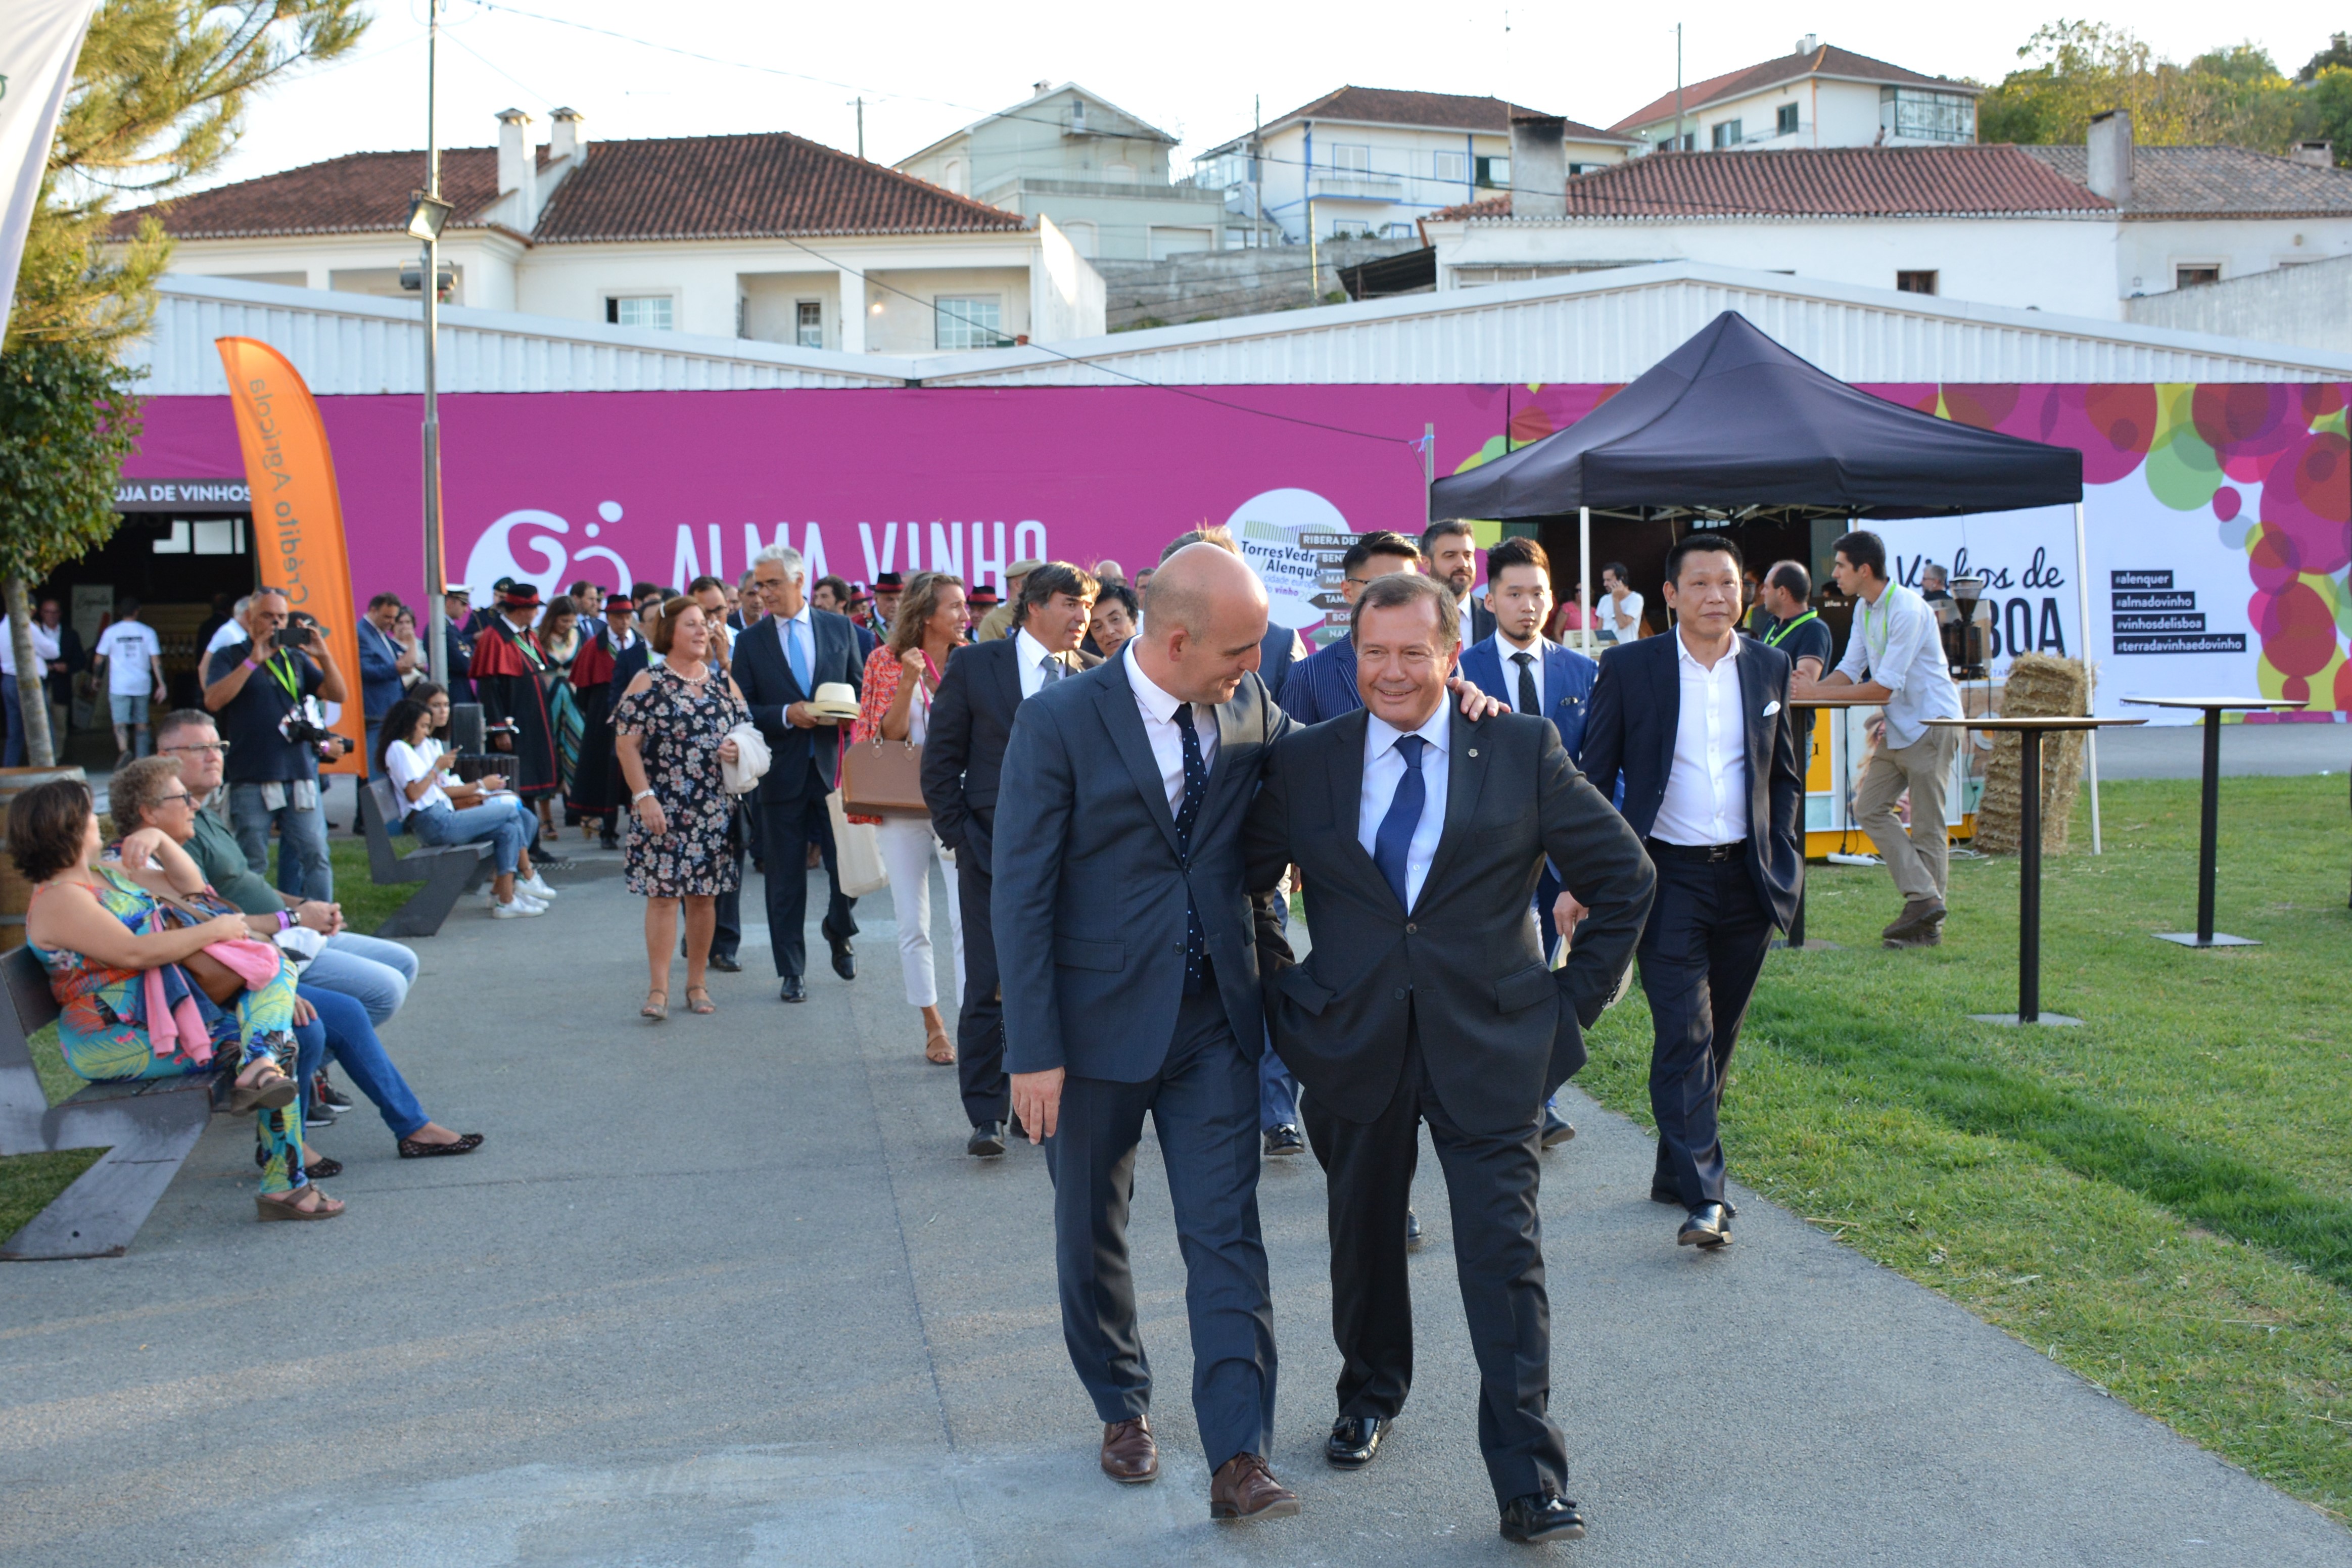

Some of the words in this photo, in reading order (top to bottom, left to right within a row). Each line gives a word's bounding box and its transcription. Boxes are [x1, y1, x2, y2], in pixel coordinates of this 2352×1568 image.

[113, 484, 147, 502] OJA
[150, 484, 176, 502] DE
[178, 484, 252, 502] VINHOS
[1303, 536, 1340, 546] RIBERA
[1241, 541, 1318, 563] TorresVedr
[1322, 553, 1345, 563] BEN
[2023, 546, 2064, 589] de
[2115, 572, 2170, 588] #alenquer
[1275, 586, 1299, 596] vinho
[2115, 594, 2192, 608] #almadovinho
[2116, 616, 2202, 630] #vinhosdelisboa
[2117, 637, 2242, 652] #terradavinhaedovinho
